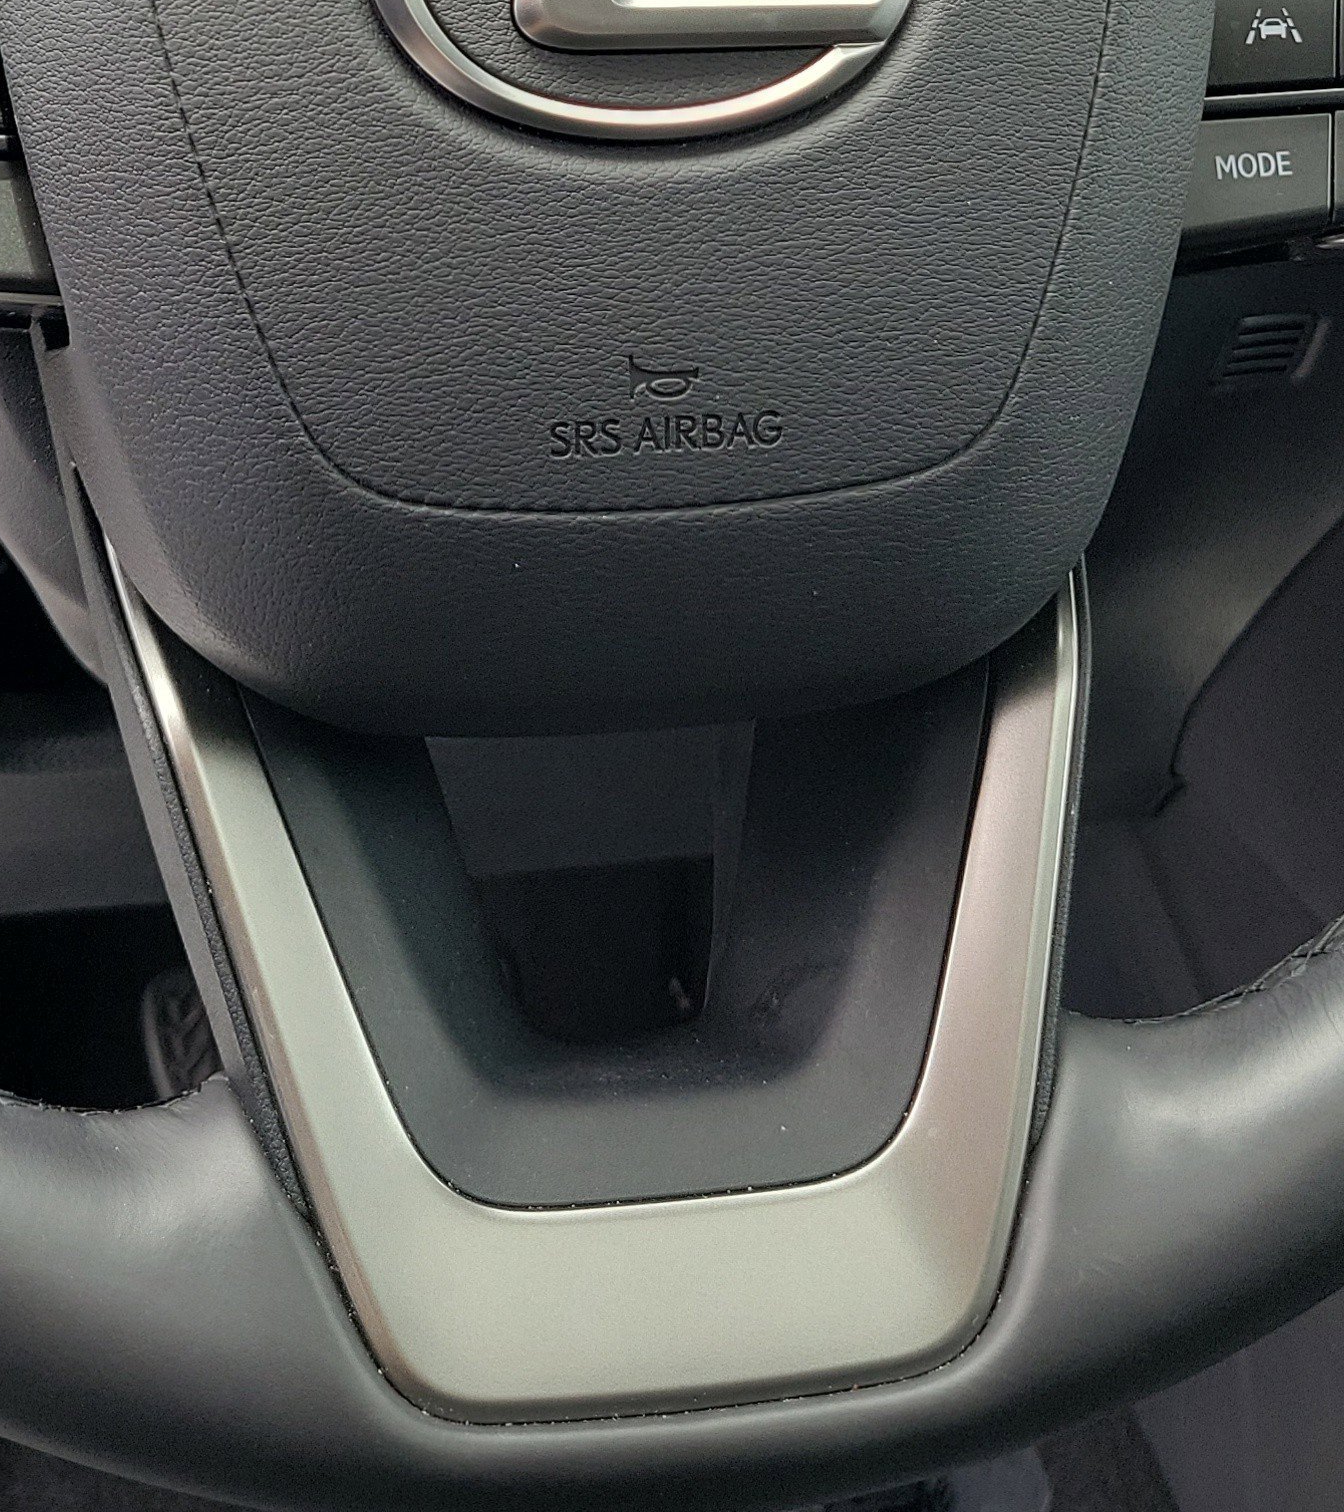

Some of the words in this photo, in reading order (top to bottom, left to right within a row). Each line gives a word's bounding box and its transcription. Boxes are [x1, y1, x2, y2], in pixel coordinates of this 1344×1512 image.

[1214, 151, 1293, 181] MODE
[548, 417, 623, 459] SRS
[633, 409, 784, 454] AIRBAG
